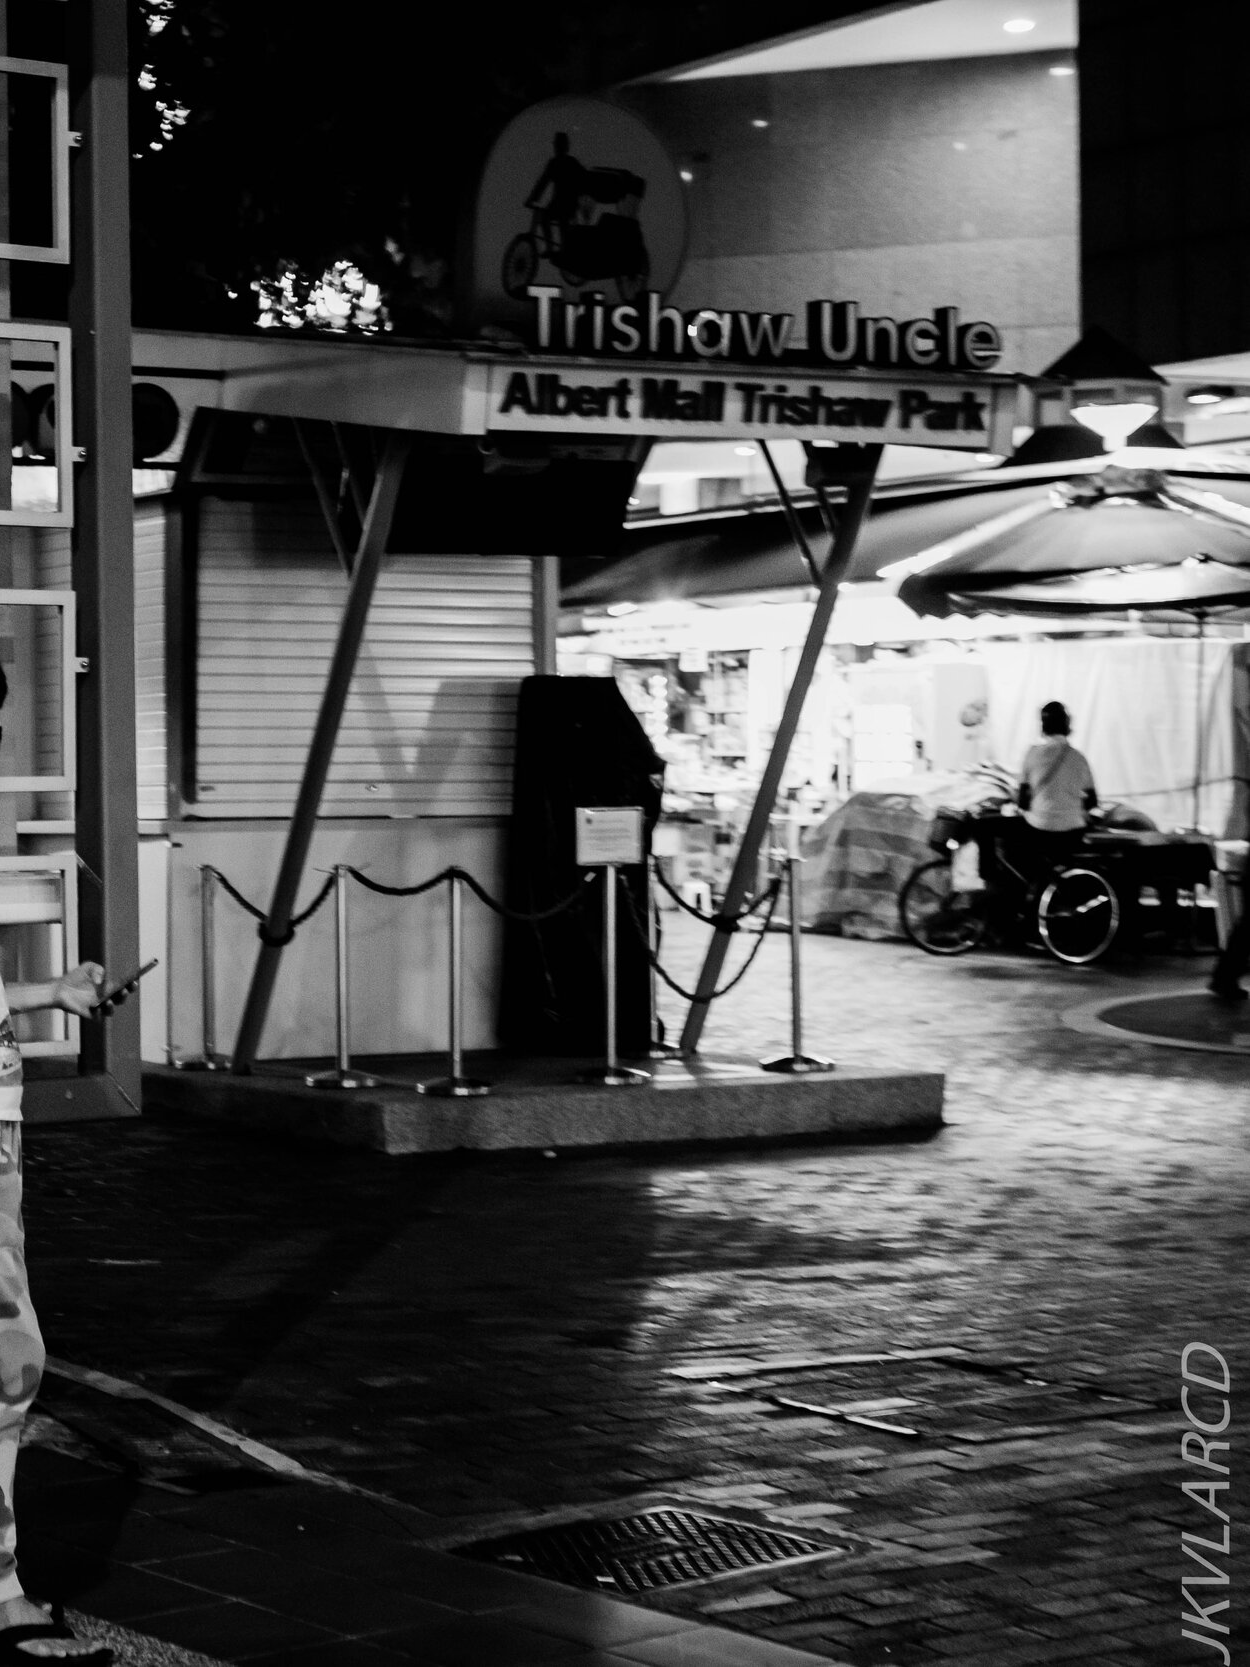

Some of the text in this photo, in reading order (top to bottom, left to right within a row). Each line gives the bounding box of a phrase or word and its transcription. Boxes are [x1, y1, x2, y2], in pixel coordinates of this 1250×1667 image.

[527, 283, 1002, 370] Trishaw Uncle
[498, 371, 989, 431] Albert Mall Trishaw Park
